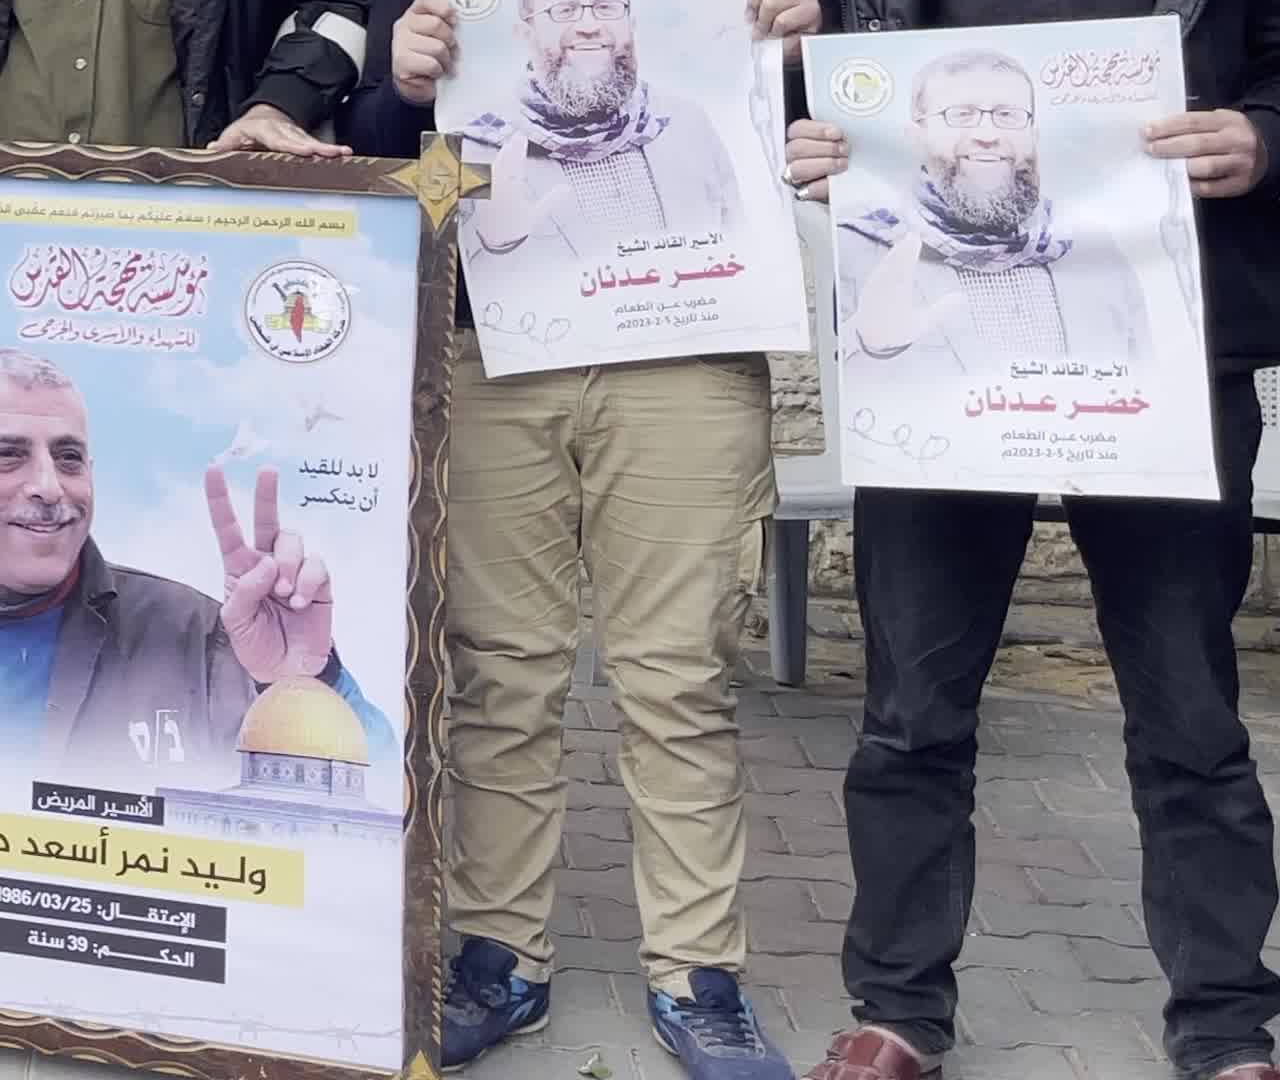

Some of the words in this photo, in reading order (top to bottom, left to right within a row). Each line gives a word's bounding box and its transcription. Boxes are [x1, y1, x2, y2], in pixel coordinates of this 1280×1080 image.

[579, 264, 661, 298] عدنان
[668, 253, 745, 288] خضر
[965, 385, 1057, 417] عدنان
[1064, 389, 1151, 420] خضر
[299, 458, 343, 479] للقيد
[299, 487, 356, 511] ينكسر
[359, 487, 379, 512] أن
[37, 791, 96, 812] المريض
[101, 795, 153, 818] الأسير
[21, 826, 110, 866] أسعد
[115, 846, 170, 877] نمر
[181, 855, 267, 895] وليد
[27, 929, 65, 950] سنة
[66, 934, 88, 954] 39
